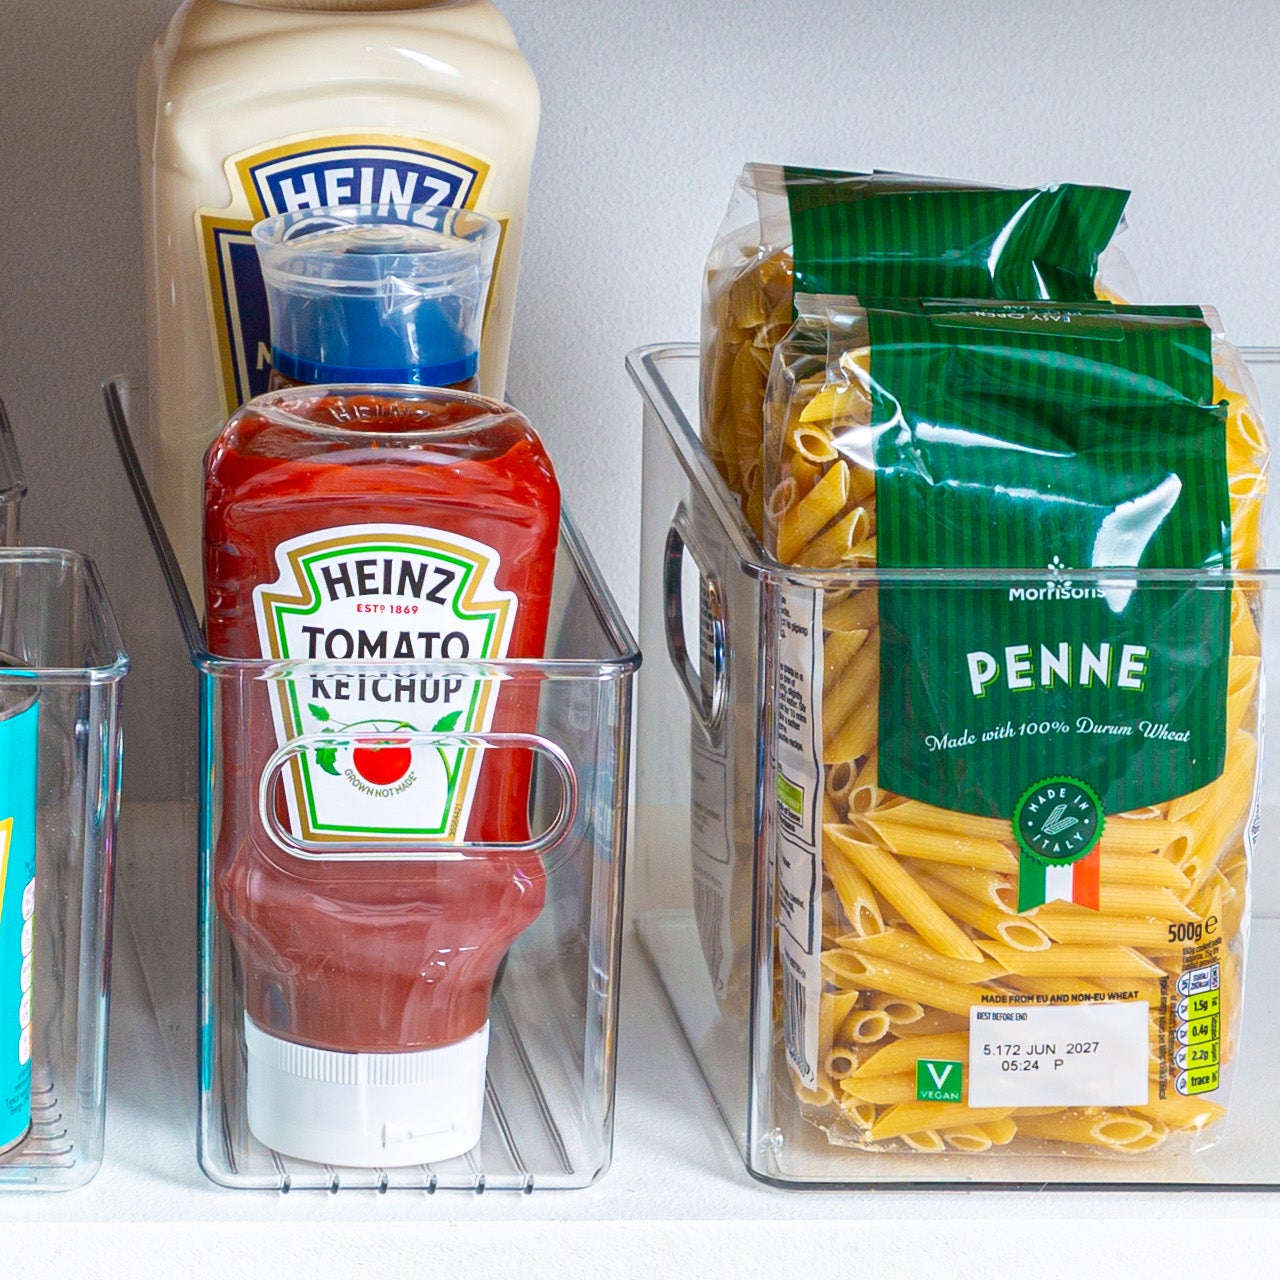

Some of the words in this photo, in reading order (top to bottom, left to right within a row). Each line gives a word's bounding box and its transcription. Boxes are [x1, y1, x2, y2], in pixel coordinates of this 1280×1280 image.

[279, 168, 452, 228] HEINZ
[320, 559, 456, 604] HEINZ
[966, 642, 1149, 698] PENNE
[925, 734, 975, 751] Made
[982, 725, 1016, 743] with
[1019, 721, 1069, 736] 100%
[1075, 718, 1132, 735] Durum
[1138, 721, 1191, 743] Wheat
[344, 769, 374, 796] GROWN
[1037, 832, 1084, 853] ITALY
[1168, 922, 1203, 943] 500g
[1050, 994, 1069, 1002] AND
[1071, 993, 1105, 1002] NON-EU
[1108, 991, 1138, 1000] WHEAT
[977, 1012, 991, 1020] BEST
[992, 1012, 1014, 1021] BEFORE
[983, 1044, 1021, 1055] 5.172
[1026, 1044, 1056, 1055] JUN
[1066, 1042, 1099, 1054] 2027
[1002, 1060, 1039, 1071] 05:24
[920, 1091, 959, 1100] VEGAN
